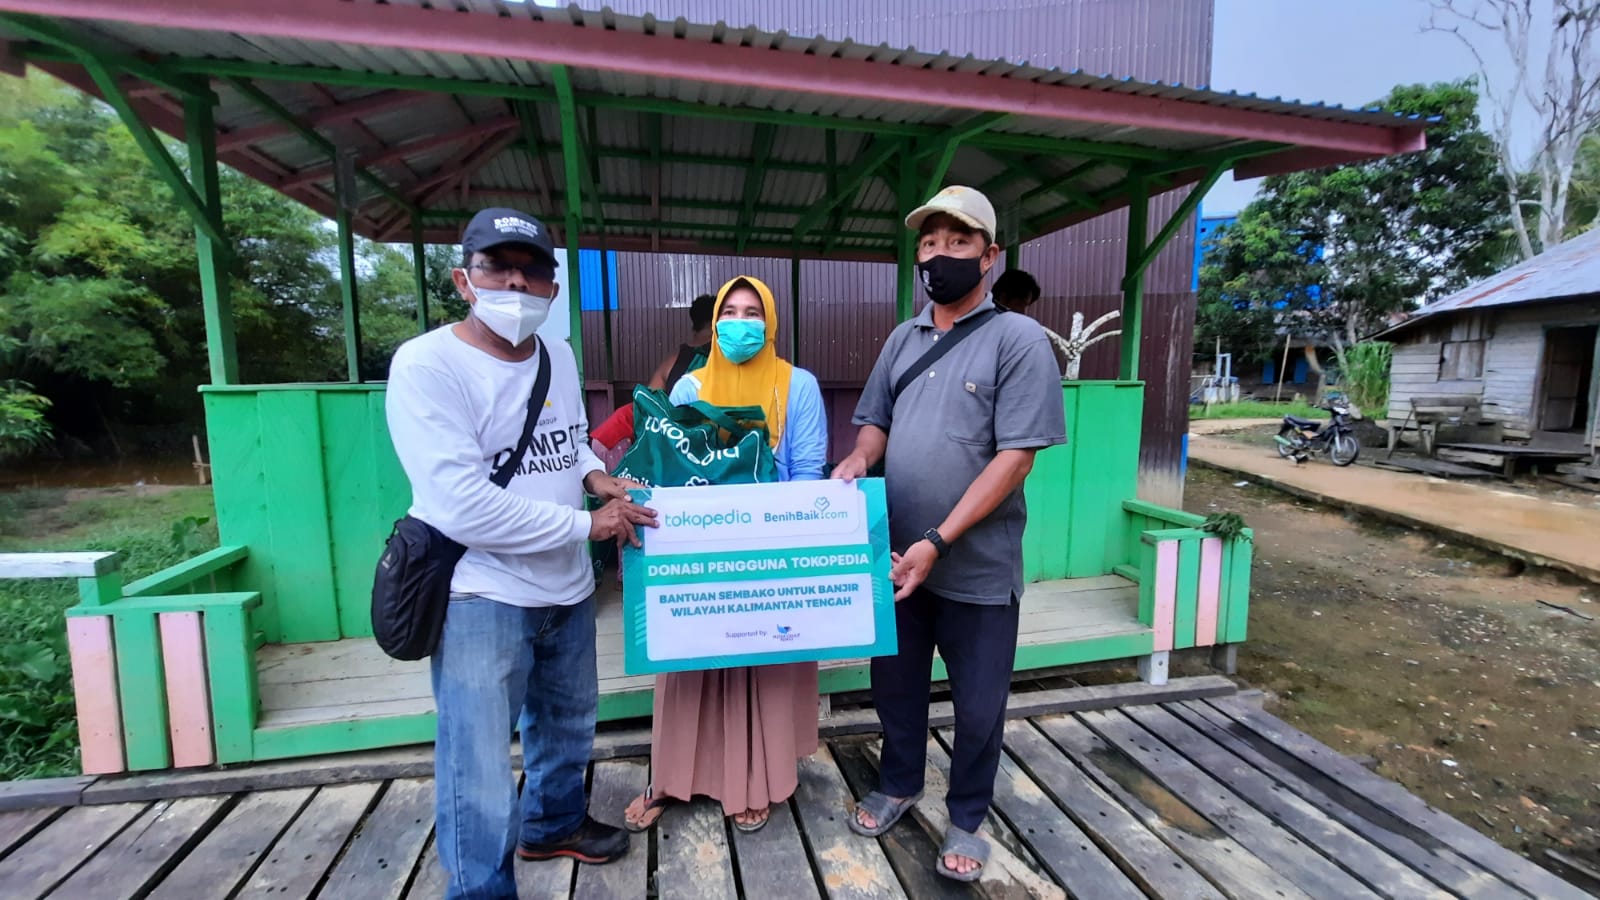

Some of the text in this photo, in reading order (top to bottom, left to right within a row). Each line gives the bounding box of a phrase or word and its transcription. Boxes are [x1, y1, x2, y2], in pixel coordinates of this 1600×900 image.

[665, 509, 752, 529] tokopedia
[648, 553, 870, 577] DONASI PENGGUNA TOKOPEDIA
[659, 583, 860, 604] BANTUAN SEMBAKO UNTUK BANJIR
[670, 596, 853, 617] WILAYAH KALIMANTAN TENGAH
[725, 630, 758, 639] Supported
